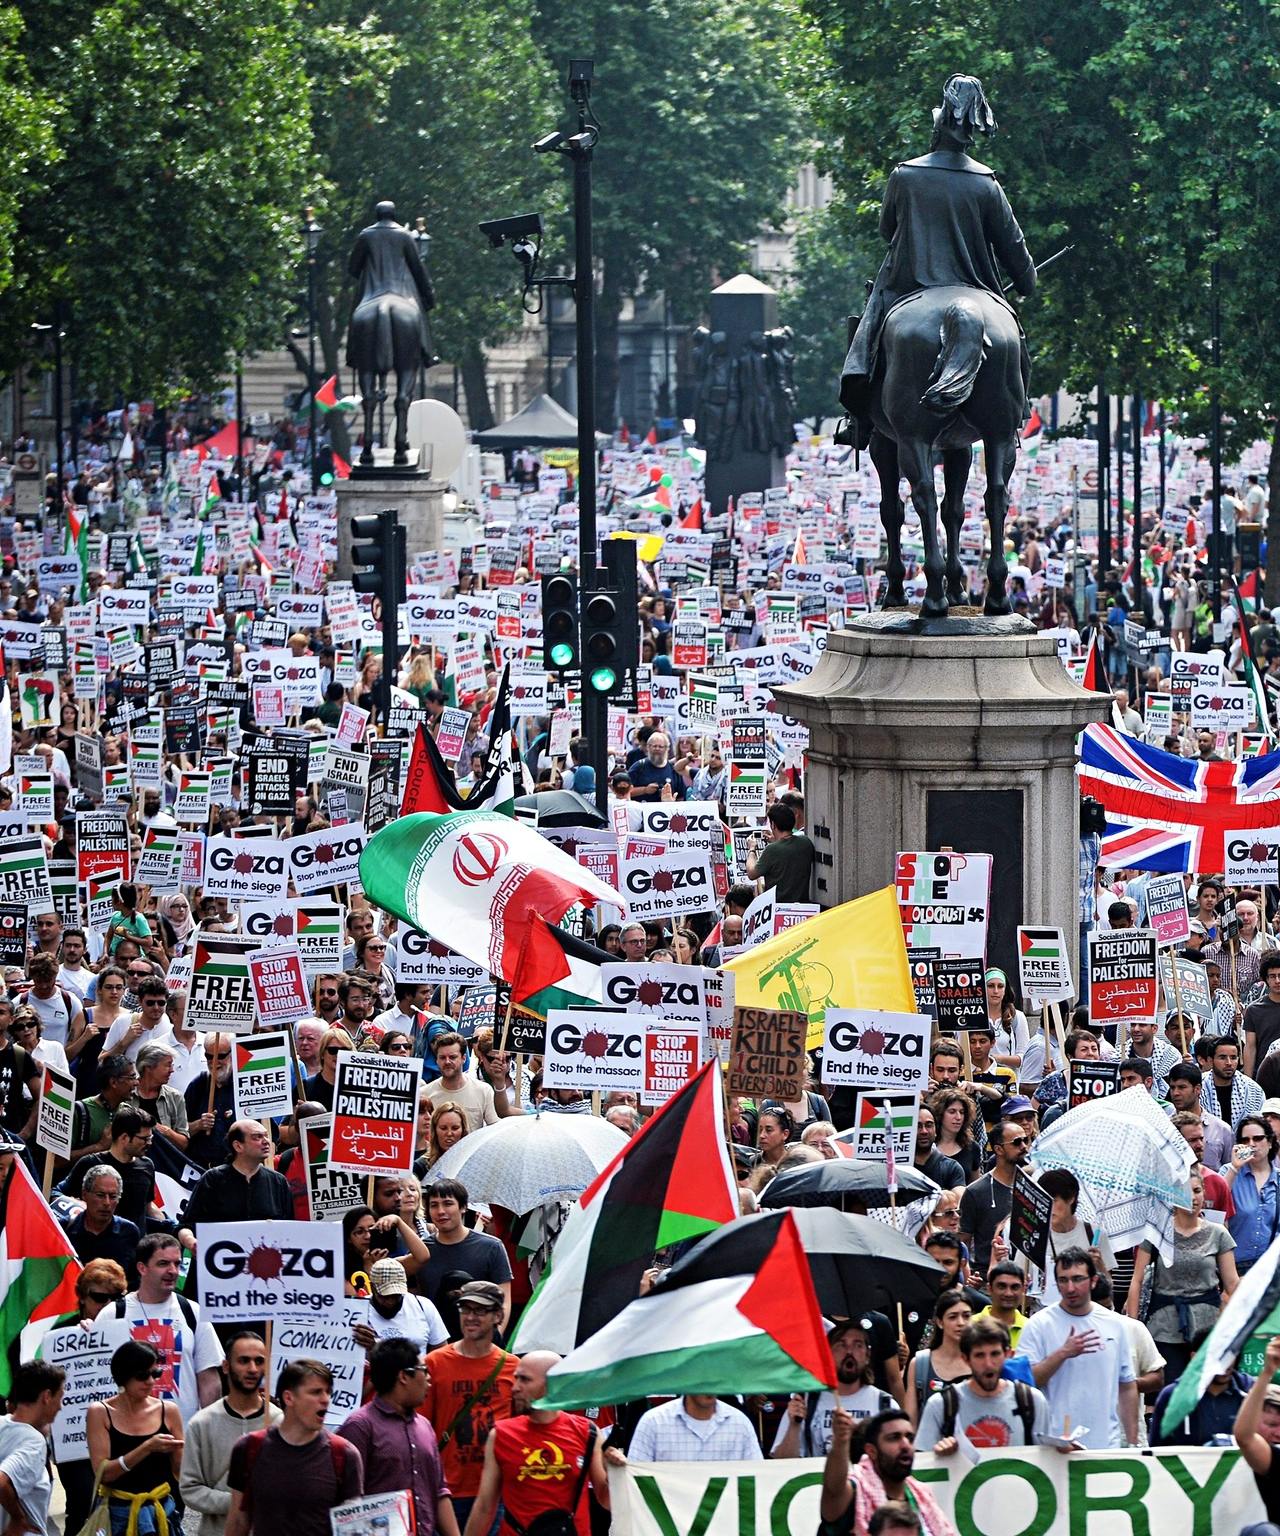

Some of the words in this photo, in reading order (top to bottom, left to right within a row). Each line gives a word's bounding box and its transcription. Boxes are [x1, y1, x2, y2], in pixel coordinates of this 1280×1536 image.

[174, 582, 215, 595] Gza
[102, 595, 145, 610] Gza
[1174, 659, 1219, 676] Gza
[208, 690, 248, 700] PALESTINE
[219, 683, 237, 691] FREE
[258, 759, 287, 773] END
[255, 774, 290, 783] ISRAEL'S
[255, 783, 290, 793] ATTACKS
[255, 791, 267, 801] ON
[268, 791, 290, 801] GAZA
[82, 821, 124, 833] FREEDOM
[80, 838, 127, 851] PALESTINE
[210, 847, 284, 877] Gza
[899, 854, 967, 881] STOP
[207, 878, 229, 890] End
[232, 879, 251, 891] the
[253, 881, 282, 894] siege
[626, 866, 706, 894] Gza
[900, 880, 948, 901] THE
[1148, 882, 1181, 899] FREEDOM
[629, 901, 652, 913] End
[654, 898, 674, 910] the
[676, 893, 709, 908] siege
[1150, 897, 1185, 915] PALESTINE
[900, 905, 965, 925] HOLOCAUST
[1095, 939, 1150, 958] FREEDOM
[262, 959, 288, 973] STOP
[400, 963, 424, 974] End
[426, 963, 446, 975] the
[448, 965, 484, 978] siege
[1022, 960, 1059, 971] FREE
[1091, 963, 1155, 981] PALESTINE
[258, 971, 297, 986] ISRAELI
[937, 974, 982, 987] STOP
[1023, 970, 1060, 979] PALESTINE
[265, 984, 296, 998] STATE
[606, 976, 699, 1005] Gza
[938, 986, 982, 999] ISRAEL'S
[188, 999, 254, 1014] PALESTINE
[262, 995, 302, 1011] TERROR
[957, 997, 984, 1006] CRIMES
[940, 1006, 950, 1015] IN
[953, 1004, 984, 1016] GAZA
[738, 1010, 799, 1032] ISRAEL
[550, 1024, 642, 1057] Gza
[656, 1035, 687, 1049] STOP
[735, 1030, 801, 1057] KILLS
[829, 1021, 924, 1057] Gza
[350, 1055, 382, 1066] Socialist
[383, 1058, 410, 1068] Worker
[650, 1050, 693, 1064] ISRAELI
[734, 1052, 743, 1073] 1
[746, 1056, 798, 1078] CHILD
[549, 1062, 573, 1076] Stop
[575, 1062, 594, 1074] the
[596, 1066, 641, 1076] massacr
[655, 1063, 689, 1077] STATE
[826, 1061, 850, 1074] End
[853, 1062, 879, 1076] the
[883, 1066, 921, 1080] siege
[238, 1072, 285, 1088] FREE
[344, 1067, 411, 1091] FREEDOM
[729, 1074, 765, 1093] EVERY
[765, 1077, 774, 1095] 3
[775, 1081, 798, 1097] DAYS
[238, 1084, 287, 1097] PALESTINE
[371, 1089, 382, 1098] for
[1073, 1079, 1115, 1096] STOP
[337, 1095, 413, 1120] PALESTINE
[341, 1123, 404, 1145] لفلسطين
[348, 1142, 398, 1160] الحرية
[205, 1240, 334, 1279] Gza
[205, 1291, 242, 1308] End
[247, 1290, 279, 1307] the
[283, 1291, 335, 1311] siege
[53, 1332, 110, 1352] ISRAEL
[279, 1330, 356, 1350] COMPLICIT
[73, 1358, 95, 1369] YOUR
[66, 1416, 82, 1425] TRY
[634, 1450, 1243, 1536] VICORY
